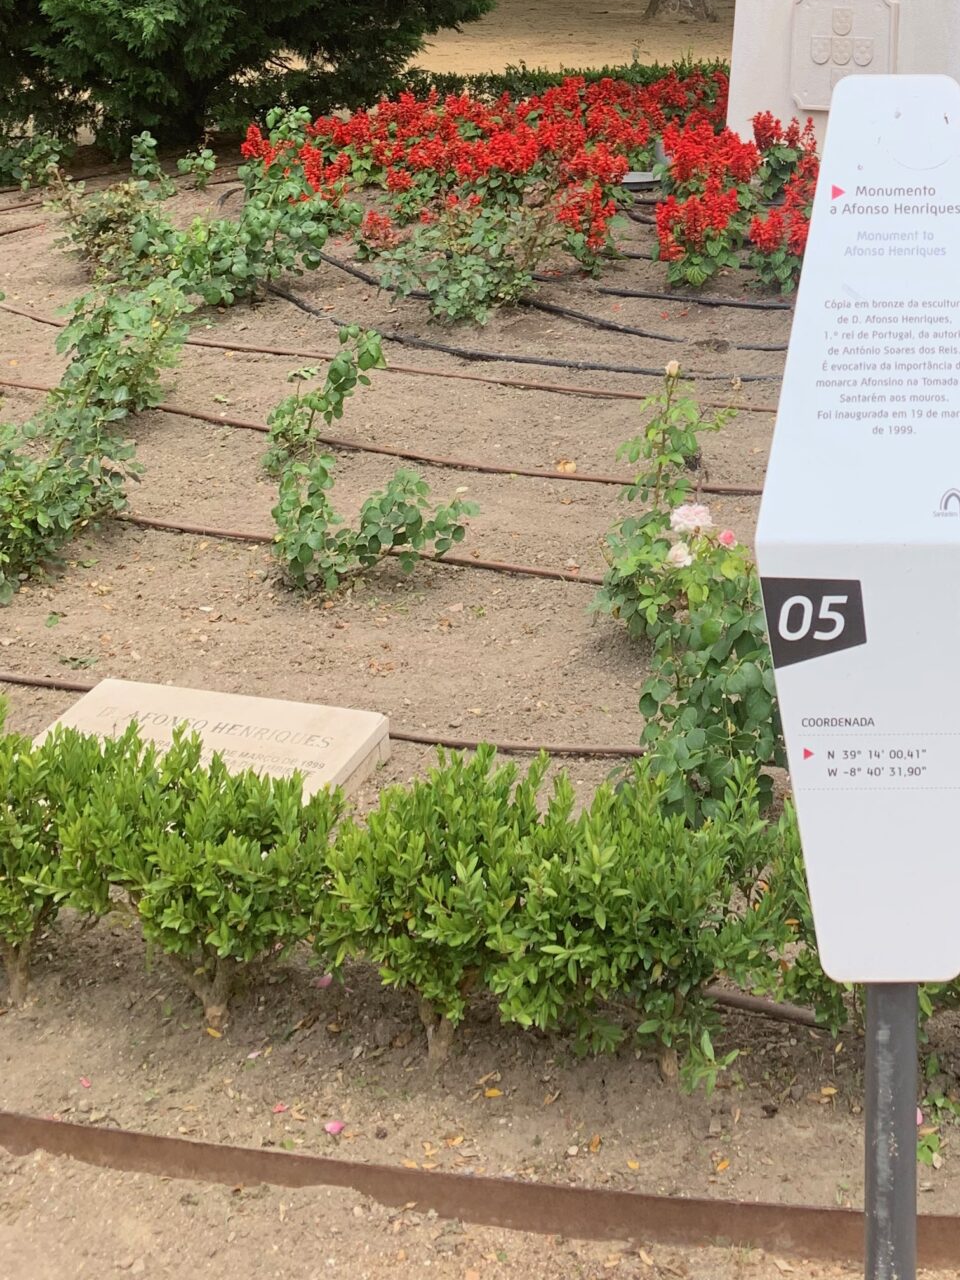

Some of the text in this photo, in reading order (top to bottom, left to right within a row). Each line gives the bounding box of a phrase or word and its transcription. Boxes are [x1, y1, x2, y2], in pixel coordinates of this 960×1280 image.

[855, 184, 937, 198] Monumento
[829, 205, 838, 216] a
[841, 202, 890, 216] Afonso
[856, 229, 935, 242] Monument to
[843, 244, 948, 259] Afonso Henriques
[823, 298, 852, 312] Cópia
[853, 300, 870, 310] em
[871, 298, 905, 309] bronze
[907, 298, 920, 309] da
[836, 314, 953, 326] de D. Afonso Henriques,
[823, 330, 839, 341] 1.º
[841, 329, 855, 341] rei
[856, 329, 870, 340] de
[871, 329, 915, 342] Portugal,
[917, 329, 930, 340] da
[827, 345, 840, 357] de
[841, 345, 882, 356] António
[883, 345, 916, 356] Soares
[918, 345, 936, 356] dos
[821, 359, 829, 372] É
[830, 361, 878, 372] evocativa
[879, 361, 892, 372] da
[894, 359, 953, 373] importância
[815, 378, 858, 388] monarca
[859, 376, 904, 388] Afonsino
[906, 378, 919, 387] na
[921, 376, 960, 387] Tomada
[839, 392, 950, 404] Santarém aos mouros.
[816, 409, 833, 421] Foi
[834, 408, 890, 422] inaugurada
[891, 410, 908, 419] em
[911, 408, 924, 419] 19
[925, 408, 939, 419] de
[871, 424, 917, 436] de 1999.
[778, 595, 849, 642] 05
[801, 716, 876, 728] COORDENADA
[211, 721, 334, 749] HENRIQUES
[827, 749, 835, 760] N
[827, 767, 838, 778] W
